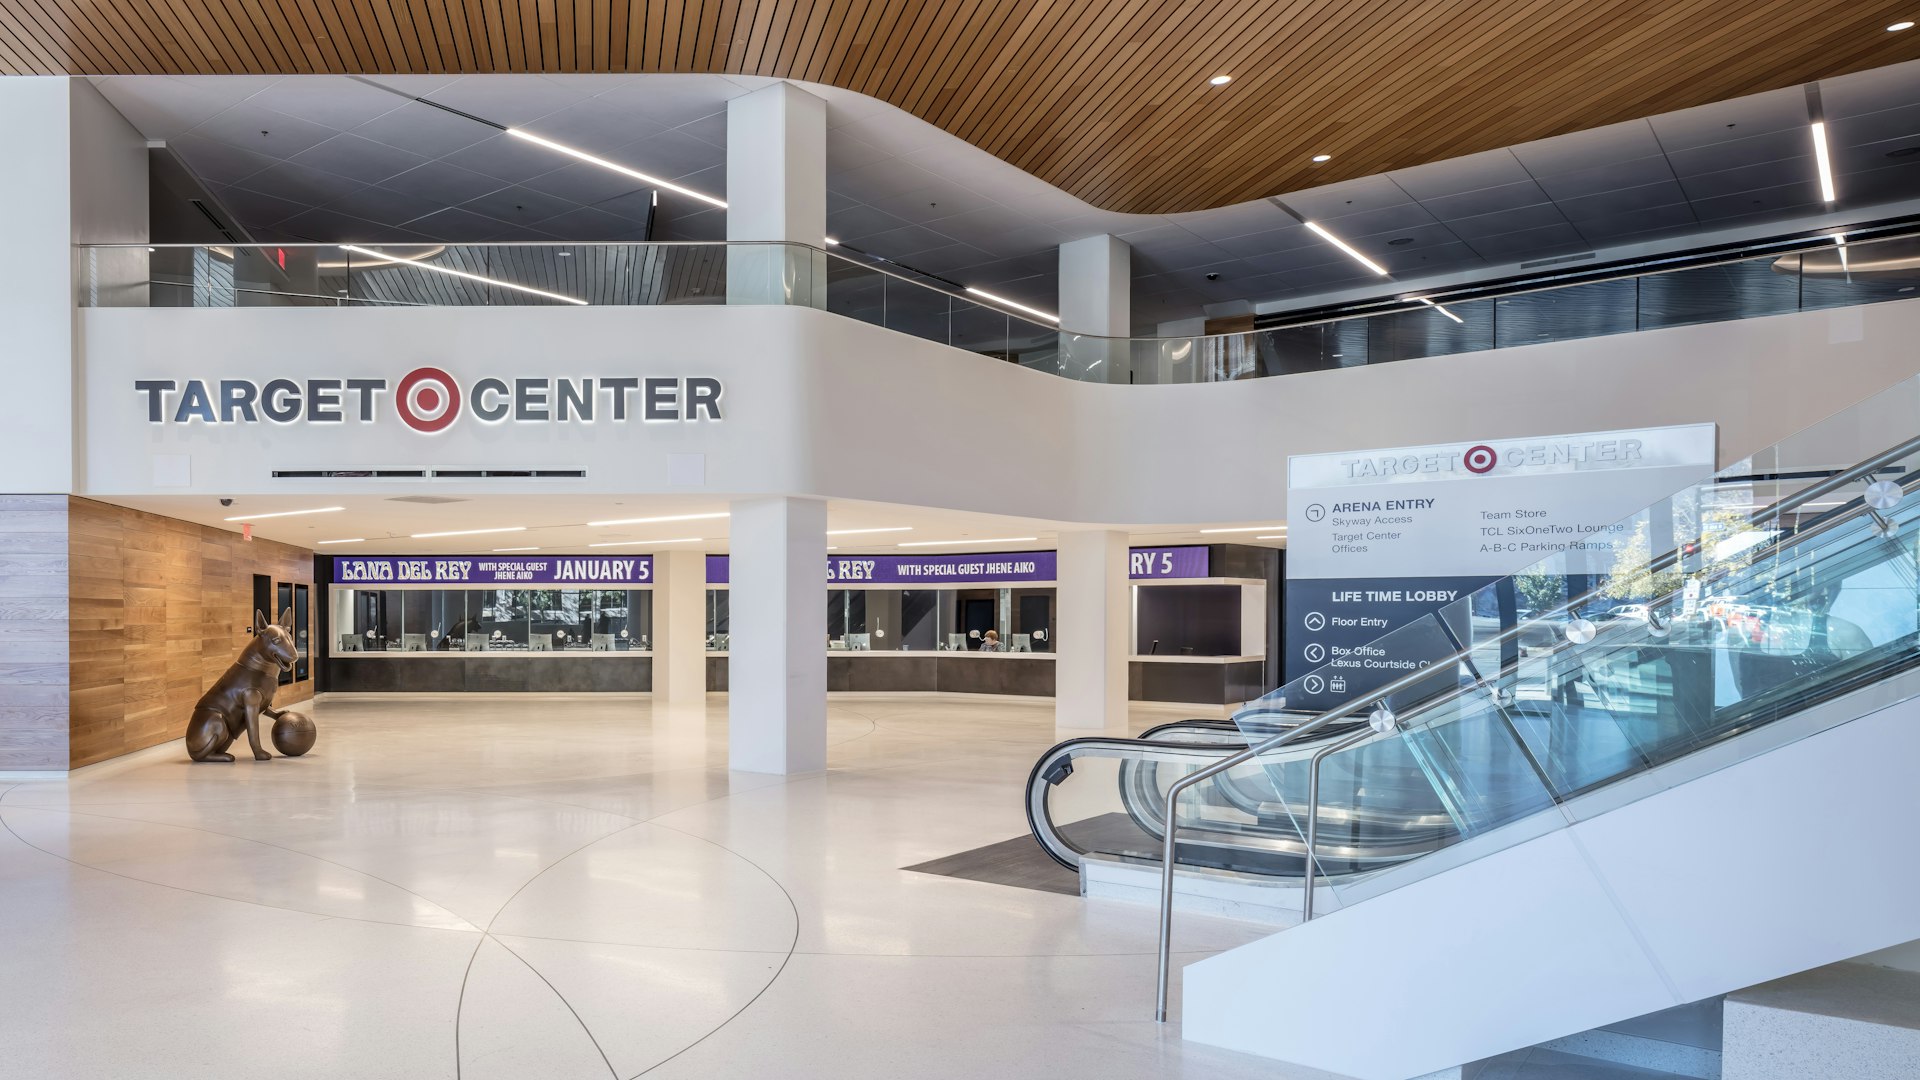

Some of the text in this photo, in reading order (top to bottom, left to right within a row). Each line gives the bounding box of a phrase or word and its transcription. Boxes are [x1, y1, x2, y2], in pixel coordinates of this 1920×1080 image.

[135, 377, 722, 423] TARGET CENTER
[1340, 438, 1642, 478] TARGET CENTER
[1332, 498, 1435, 513] ARENA ENTRY
[1480, 509, 1547, 520] Team Store
[1332, 515, 1413, 527] Skyway Access
[1480, 523, 1624, 537] TCL SixOneTwo Lounge
[1332, 531, 1402, 543] Target Center
[1331, 544, 1368, 554] Offices
[1480, 541, 1613, 553] A-B-C Parking Ramps
[478, 562, 547, 572] WITH SPECIAL GUEST
[897, 561, 1035, 576] WITH SPECIAL GUEST JHENE AIKO
[1160, 552, 1173, 574] 5
[341, 560, 472, 581] LANA DEL REY
[494, 571, 533, 580] JHENE AIKO
[554, 560, 649, 580] JANUARY 5
[838, 560, 875, 580] REY
[1332, 590, 1458, 602] LIFE TIME LOBBY
[1331, 617, 1388, 629] Floor Entry
[1331, 646, 1386, 656] Box Office
[1331, 658, 1361, 668] Lexus
[1364, 659, 1416, 669] Courtside
